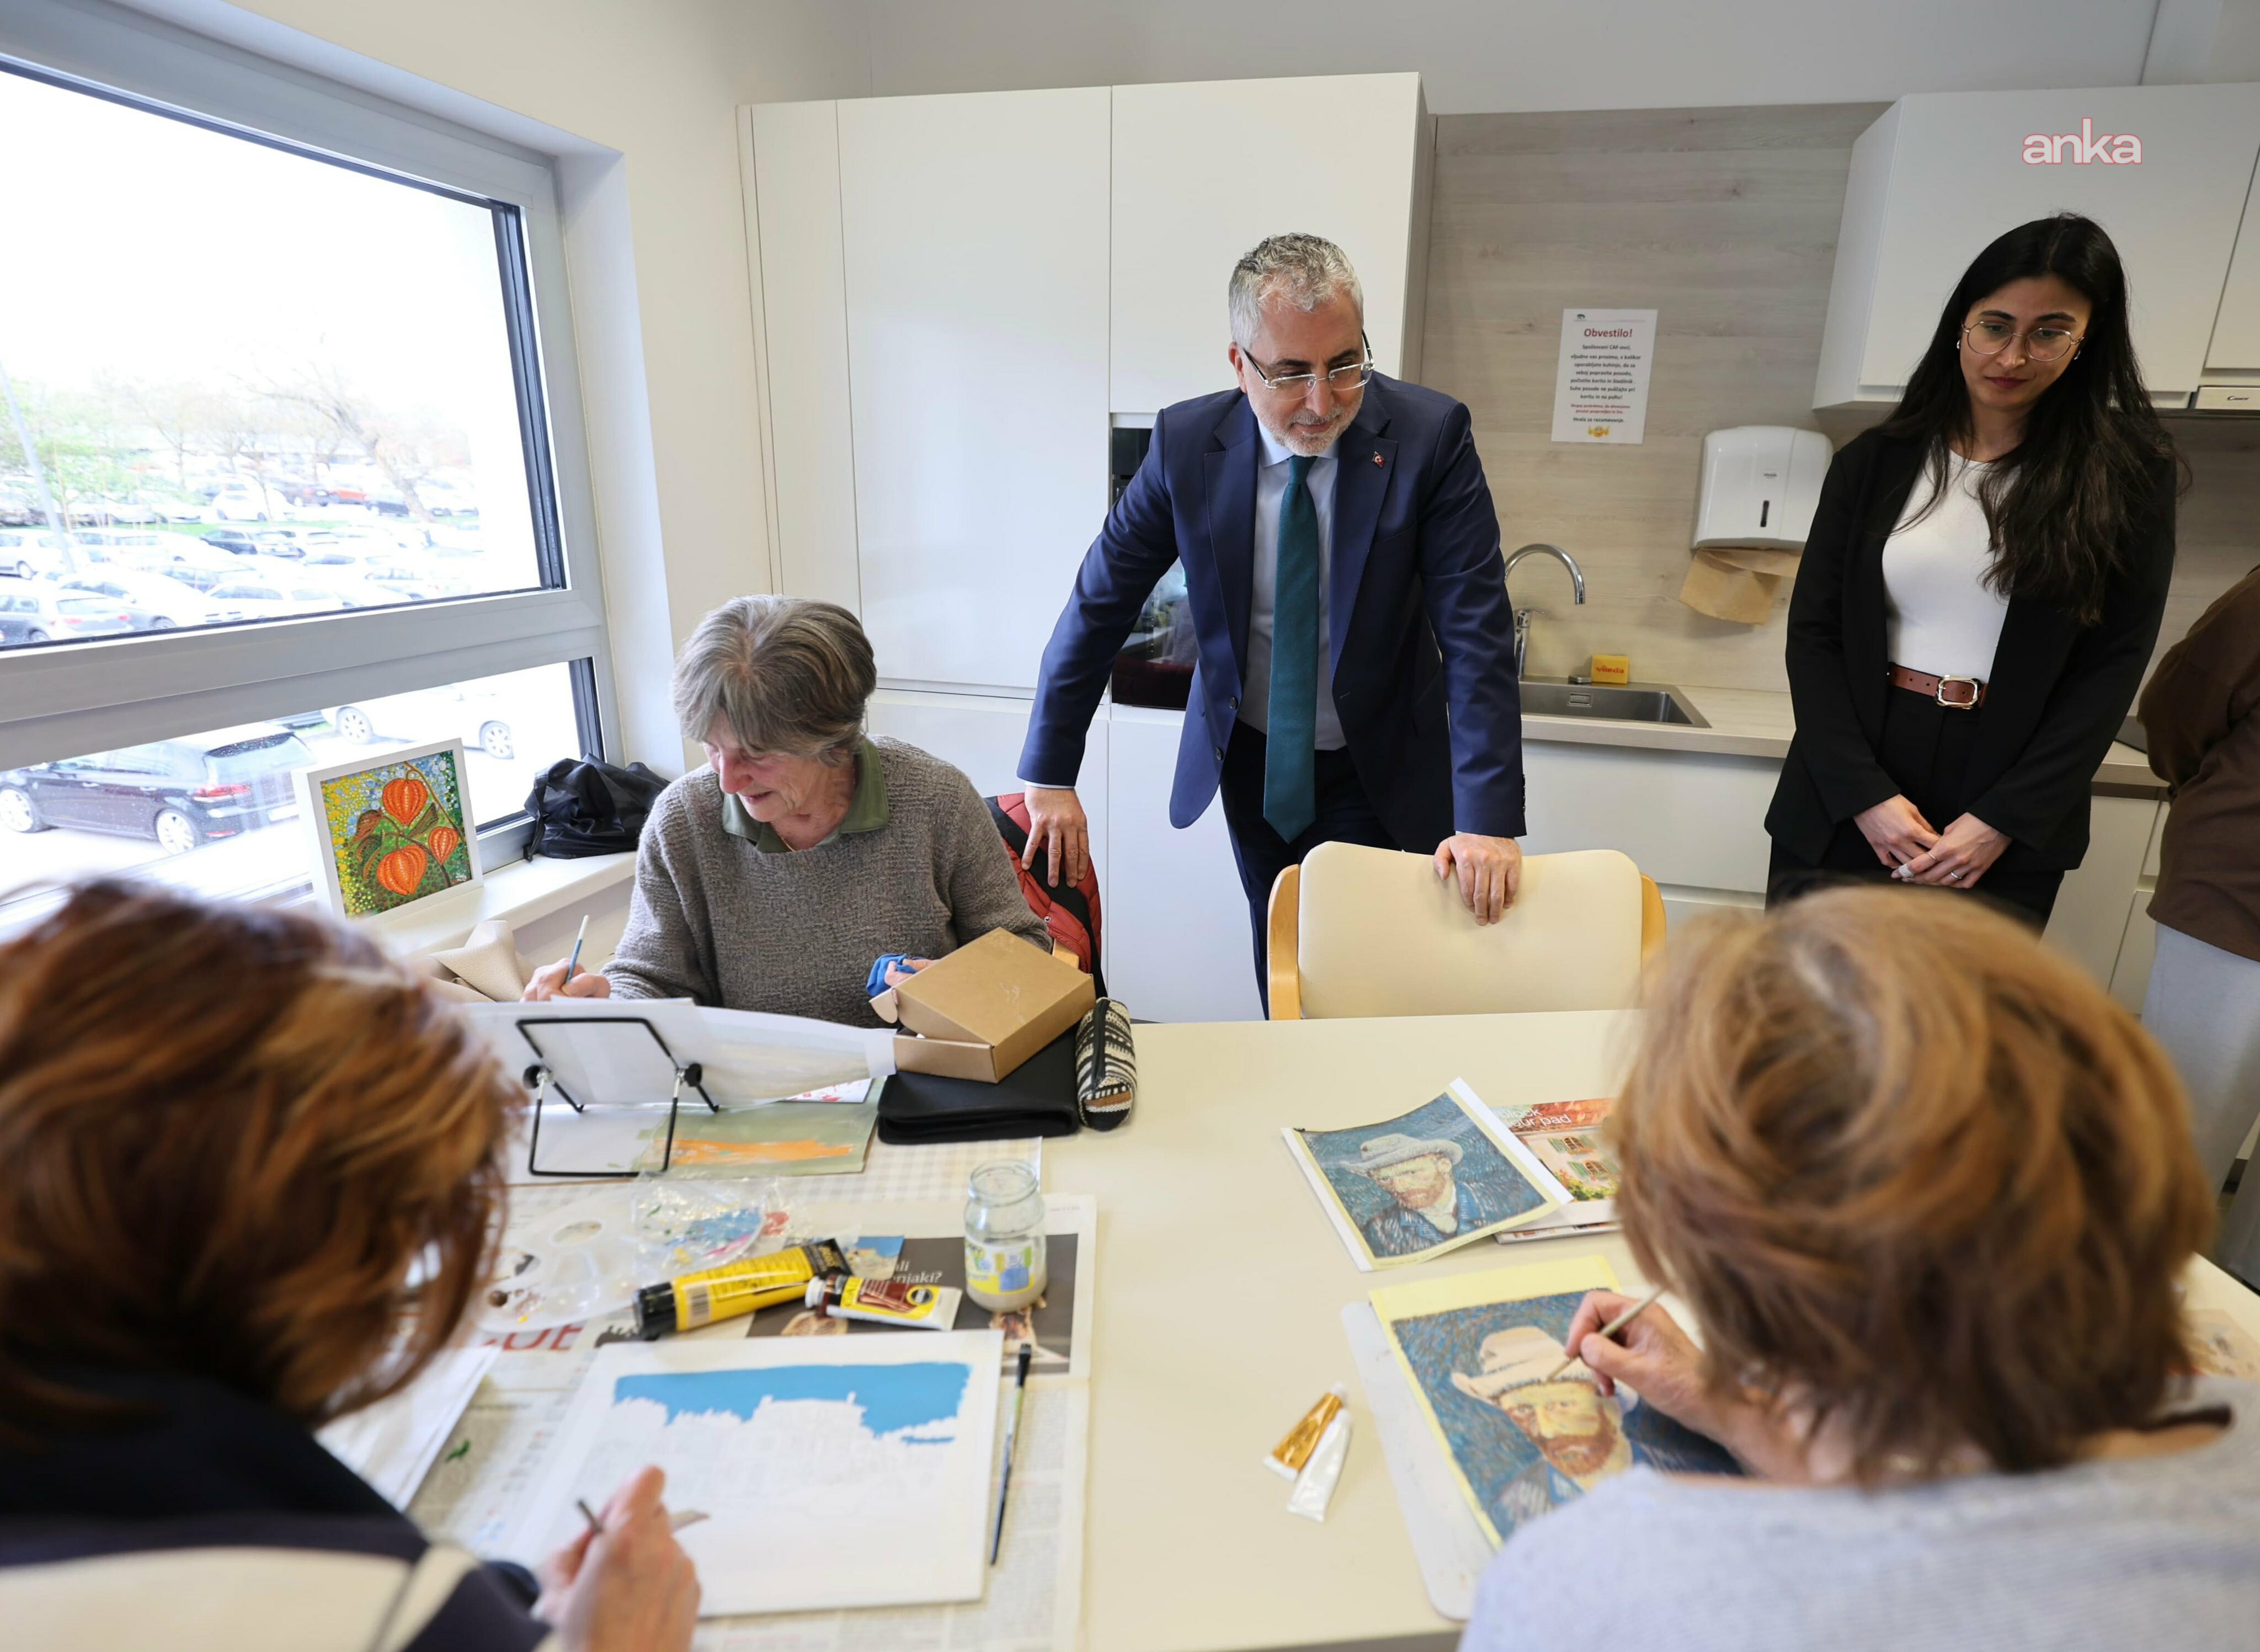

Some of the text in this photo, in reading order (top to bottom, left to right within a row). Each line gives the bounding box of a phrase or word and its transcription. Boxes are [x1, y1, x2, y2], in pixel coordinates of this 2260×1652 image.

[1584, 328, 1633, 338] Obvestilo!
[1539, 1113, 1572, 1127] pad
[894, 1270, 943, 1283] njaki?
